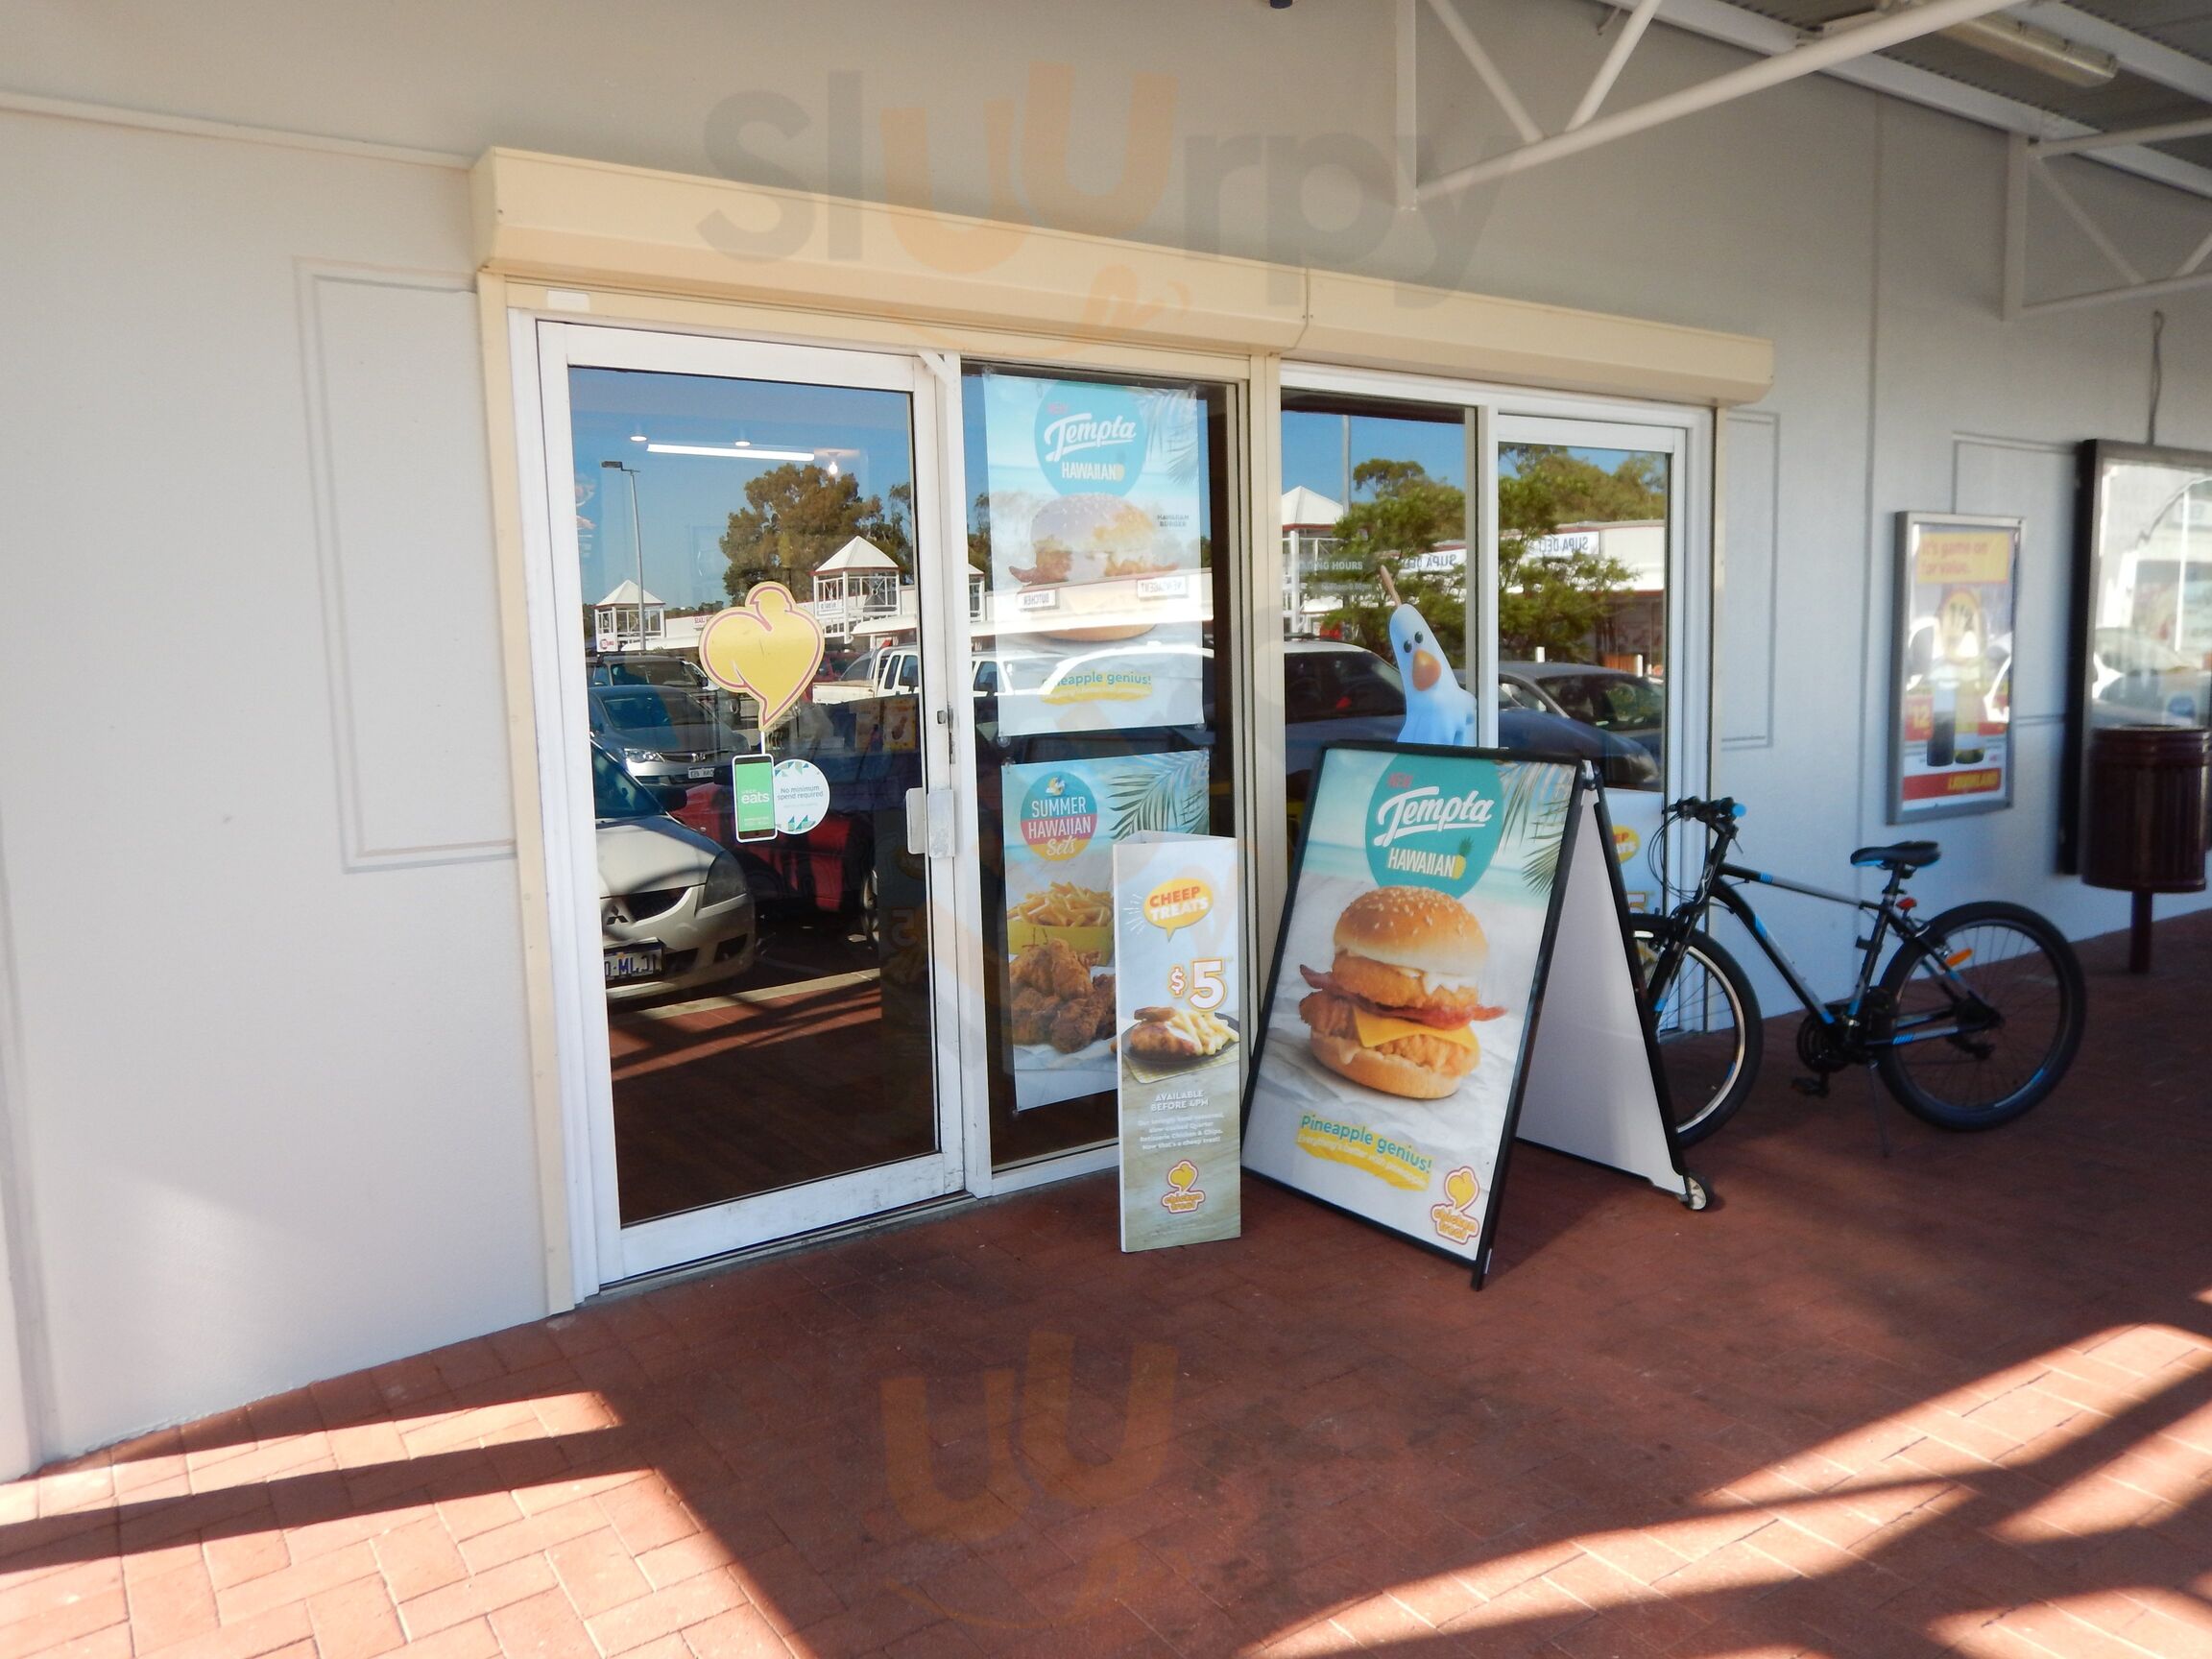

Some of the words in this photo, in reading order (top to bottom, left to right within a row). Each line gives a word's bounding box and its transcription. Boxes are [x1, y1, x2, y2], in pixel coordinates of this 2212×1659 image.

[1044, 413, 1137, 462] Tempta
[1062, 461, 1117, 480] HAWAIIAN
[1332, 561, 1363, 570] HOURS
[1106, 671, 1152, 685] genius!
[741, 791, 770, 805] eats
[777, 792, 796, 801] spend
[797, 790, 824, 800] required
[790, 785, 820, 794] minimum
[1031, 796, 1087, 818] SUMMER
[1373, 785, 1495, 848] Tempta
[1028, 815, 1092, 840] HAWAIIAN
[1046, 834, 1077, 856] Sets
[1386, 847, 1457, 878] HAWAIIAN
[1149, 885, 1200, 907] CHEEP
[1150, 897, 1209, 922] TREATS
[1151, 1099, 1188, 1112] BEFORE
[1155, 1089, 1205, 1102] AVAILABLE
[1301, 1114, 1374, 1145] Pineapple
[1376, 1138, 1432, 1174] genius!
